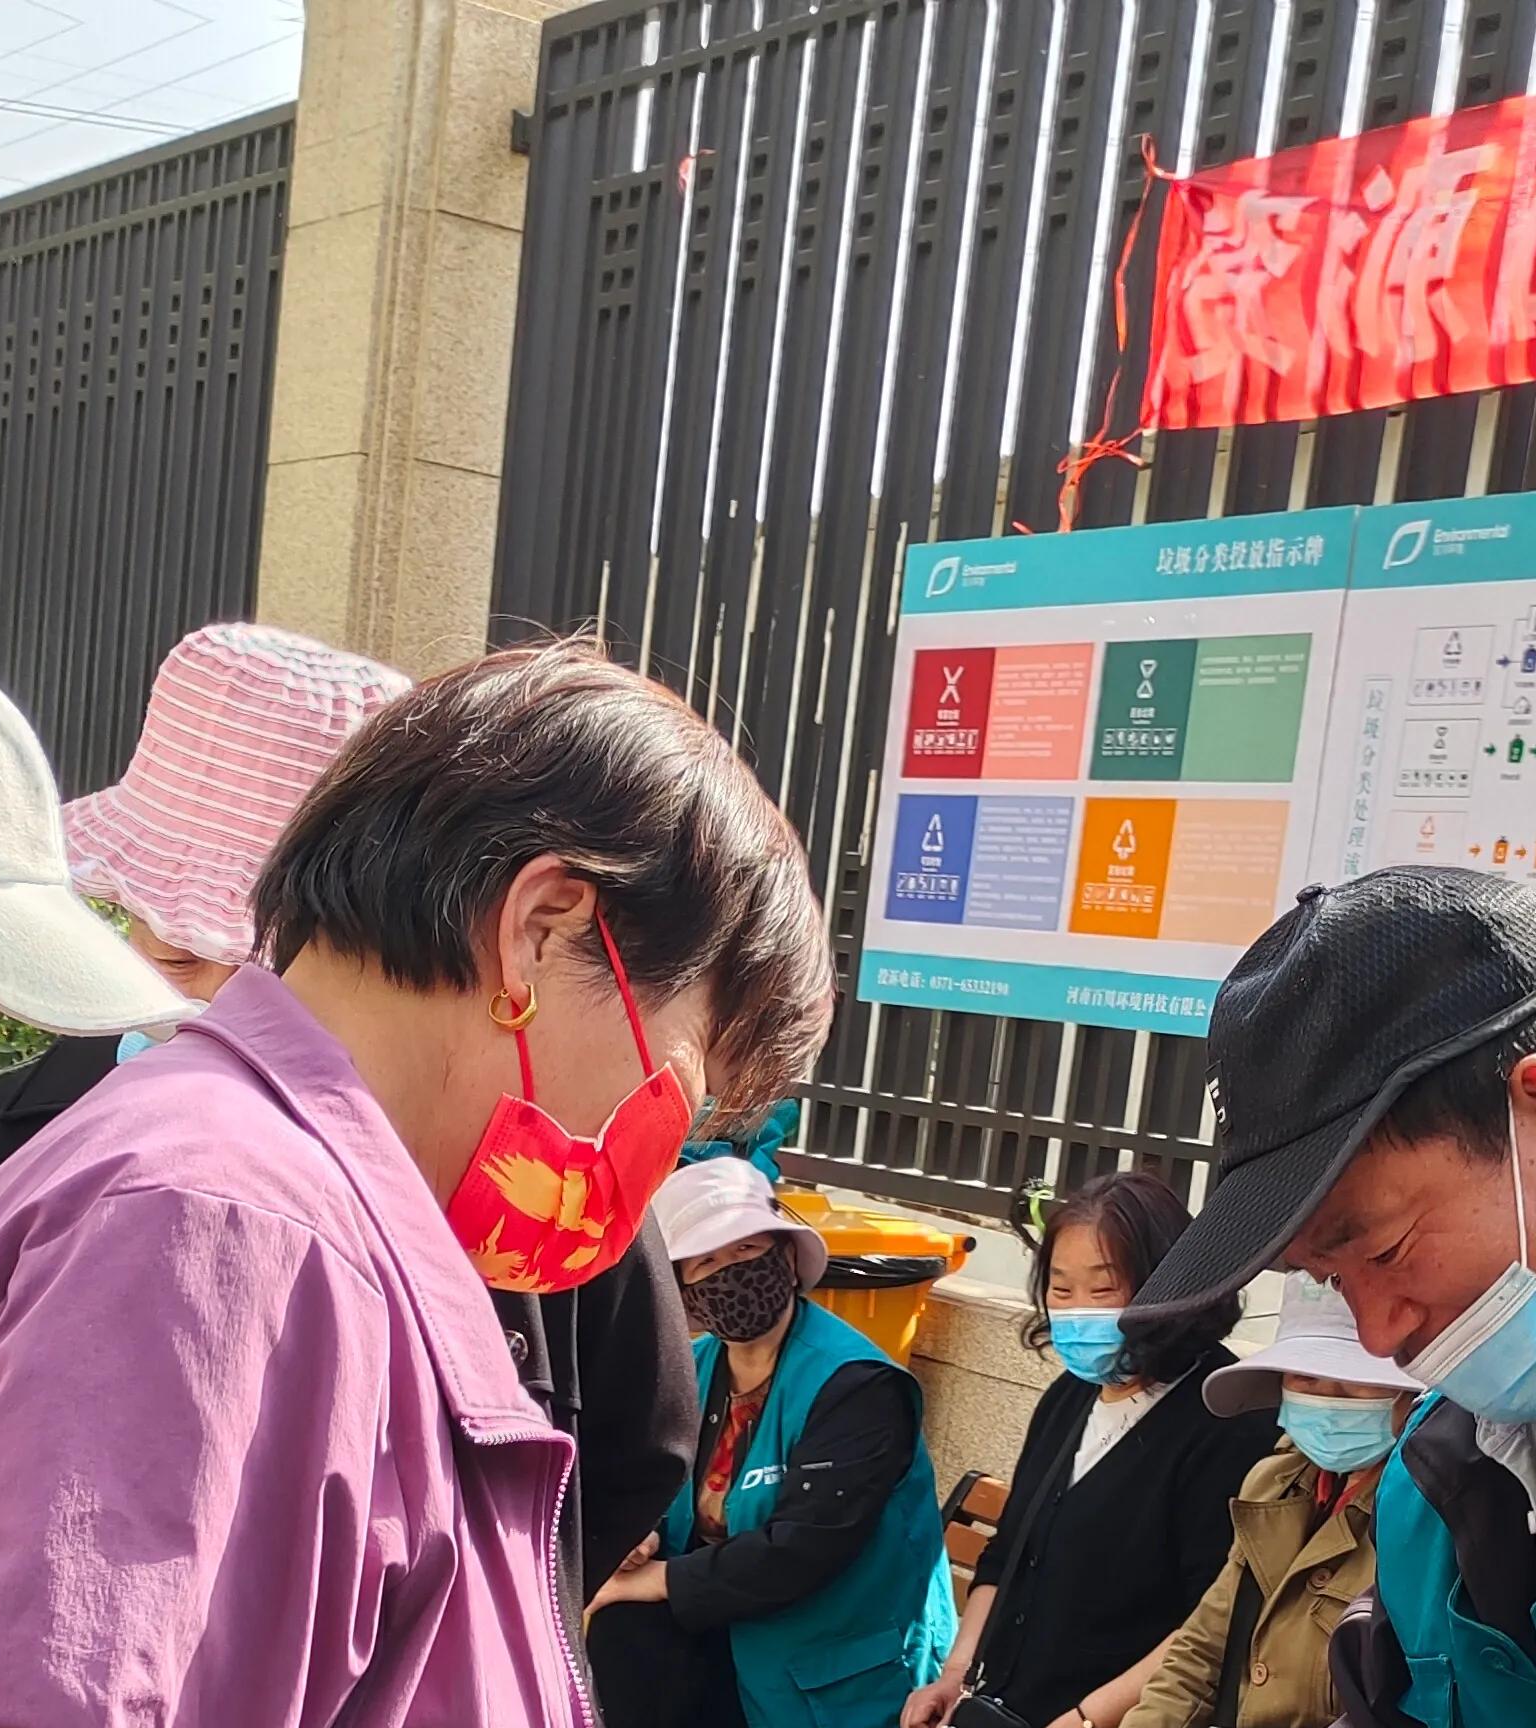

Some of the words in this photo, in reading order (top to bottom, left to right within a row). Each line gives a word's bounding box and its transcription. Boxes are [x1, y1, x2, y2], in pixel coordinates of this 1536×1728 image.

[1155, 535, 1324, 575] 垃圾分类投放指示牌
